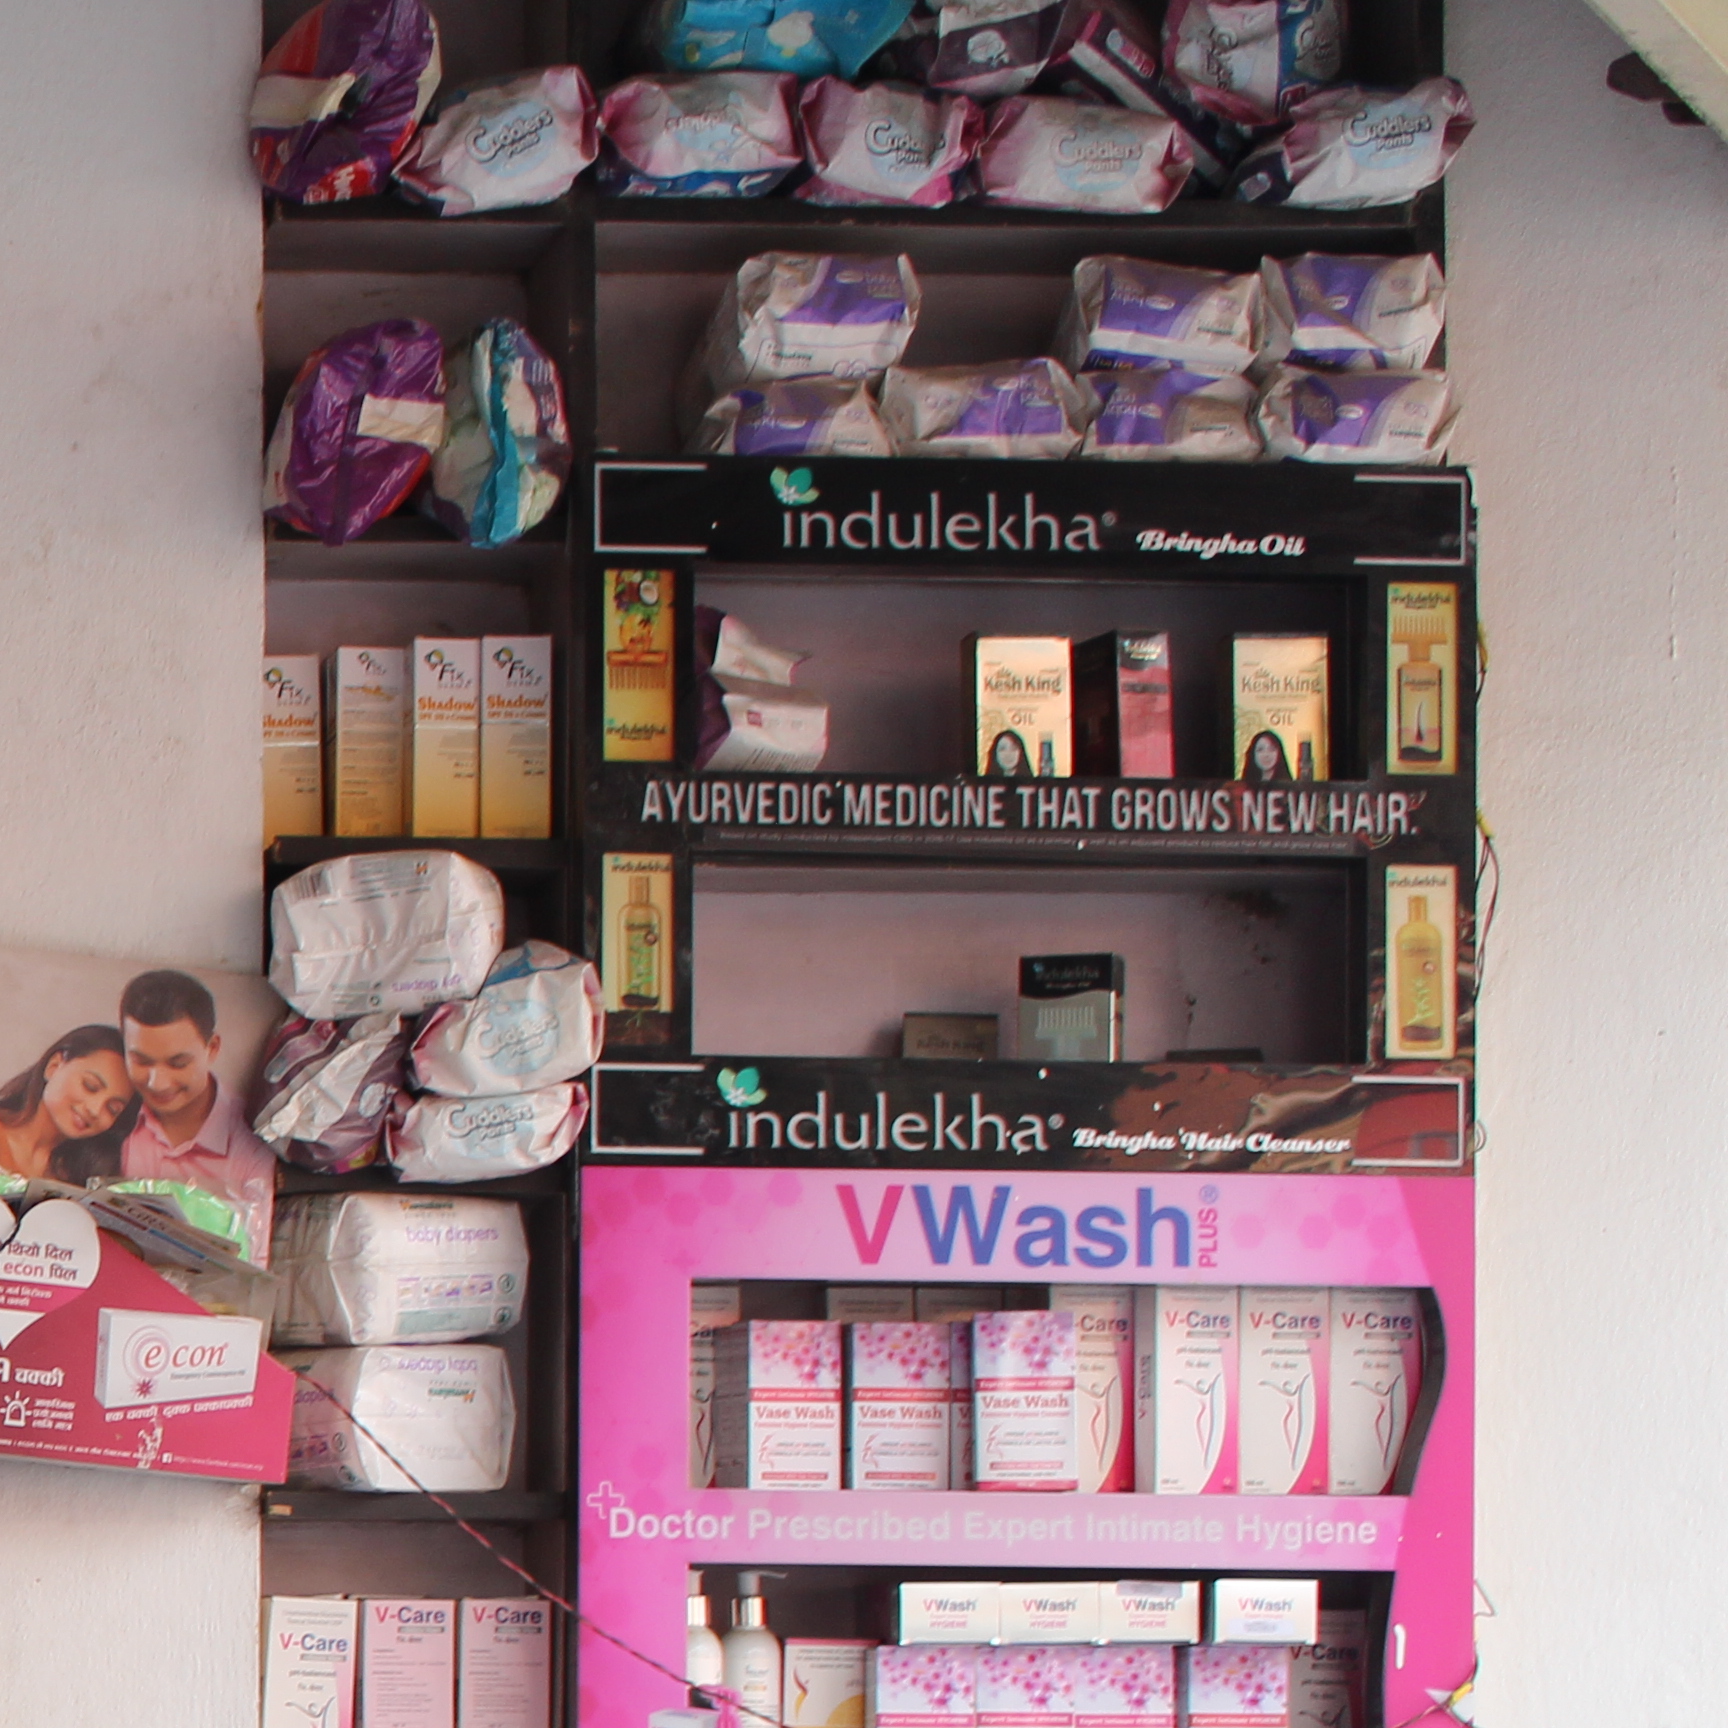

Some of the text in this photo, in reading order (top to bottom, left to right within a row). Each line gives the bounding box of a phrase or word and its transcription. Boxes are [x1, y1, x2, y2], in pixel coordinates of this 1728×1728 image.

[464, 109, 553, 163] Cuddlers
[1343, 111, 1432, 148] Cuddlers
[1135, 529, 1258, 560] Bringha
[1259, 534, 1305, 556] Oil
[983, 674, 1063, 695] Kesh King
[1009, 712, 1035, 726] OIL
[641, 780, 833, 826] AYURVEDIC
[842, 782, 1007, 829] MEDICINE
[1015, 785, 1099, 831] THAT
[1111, 788, 1235, 833] GROWS
[1242, 790, 1326, 834] NEW
[445, 1102, 534, 1139] Cuddlers
[1071, 1127, 1176, 1152] Bringha
[1180, 1128, 1242, 1154] Hair
[1245, 1131, 1352, 1155] Cleanser
[405, 1223, 499, 1245] baby diapers
[1196, 1207, 1219, 1268] PLUS
[3, 1262, 45, 1278] econ
[1165, 1310, 1231, 1329] V-Care
[1249, 1310, 1321, 1329] V-Care
[981, 1394, 1070, 1409] Vase Wash
[756, 1405, 836, 1420] Vase Wash
[608, 1505, 1377, 1557] Doctor Prescribed Expert Intimate Hygiene
[472, 1606, 543, 1625] V-Care
[279, 1632, 348, 1652] V-Care
